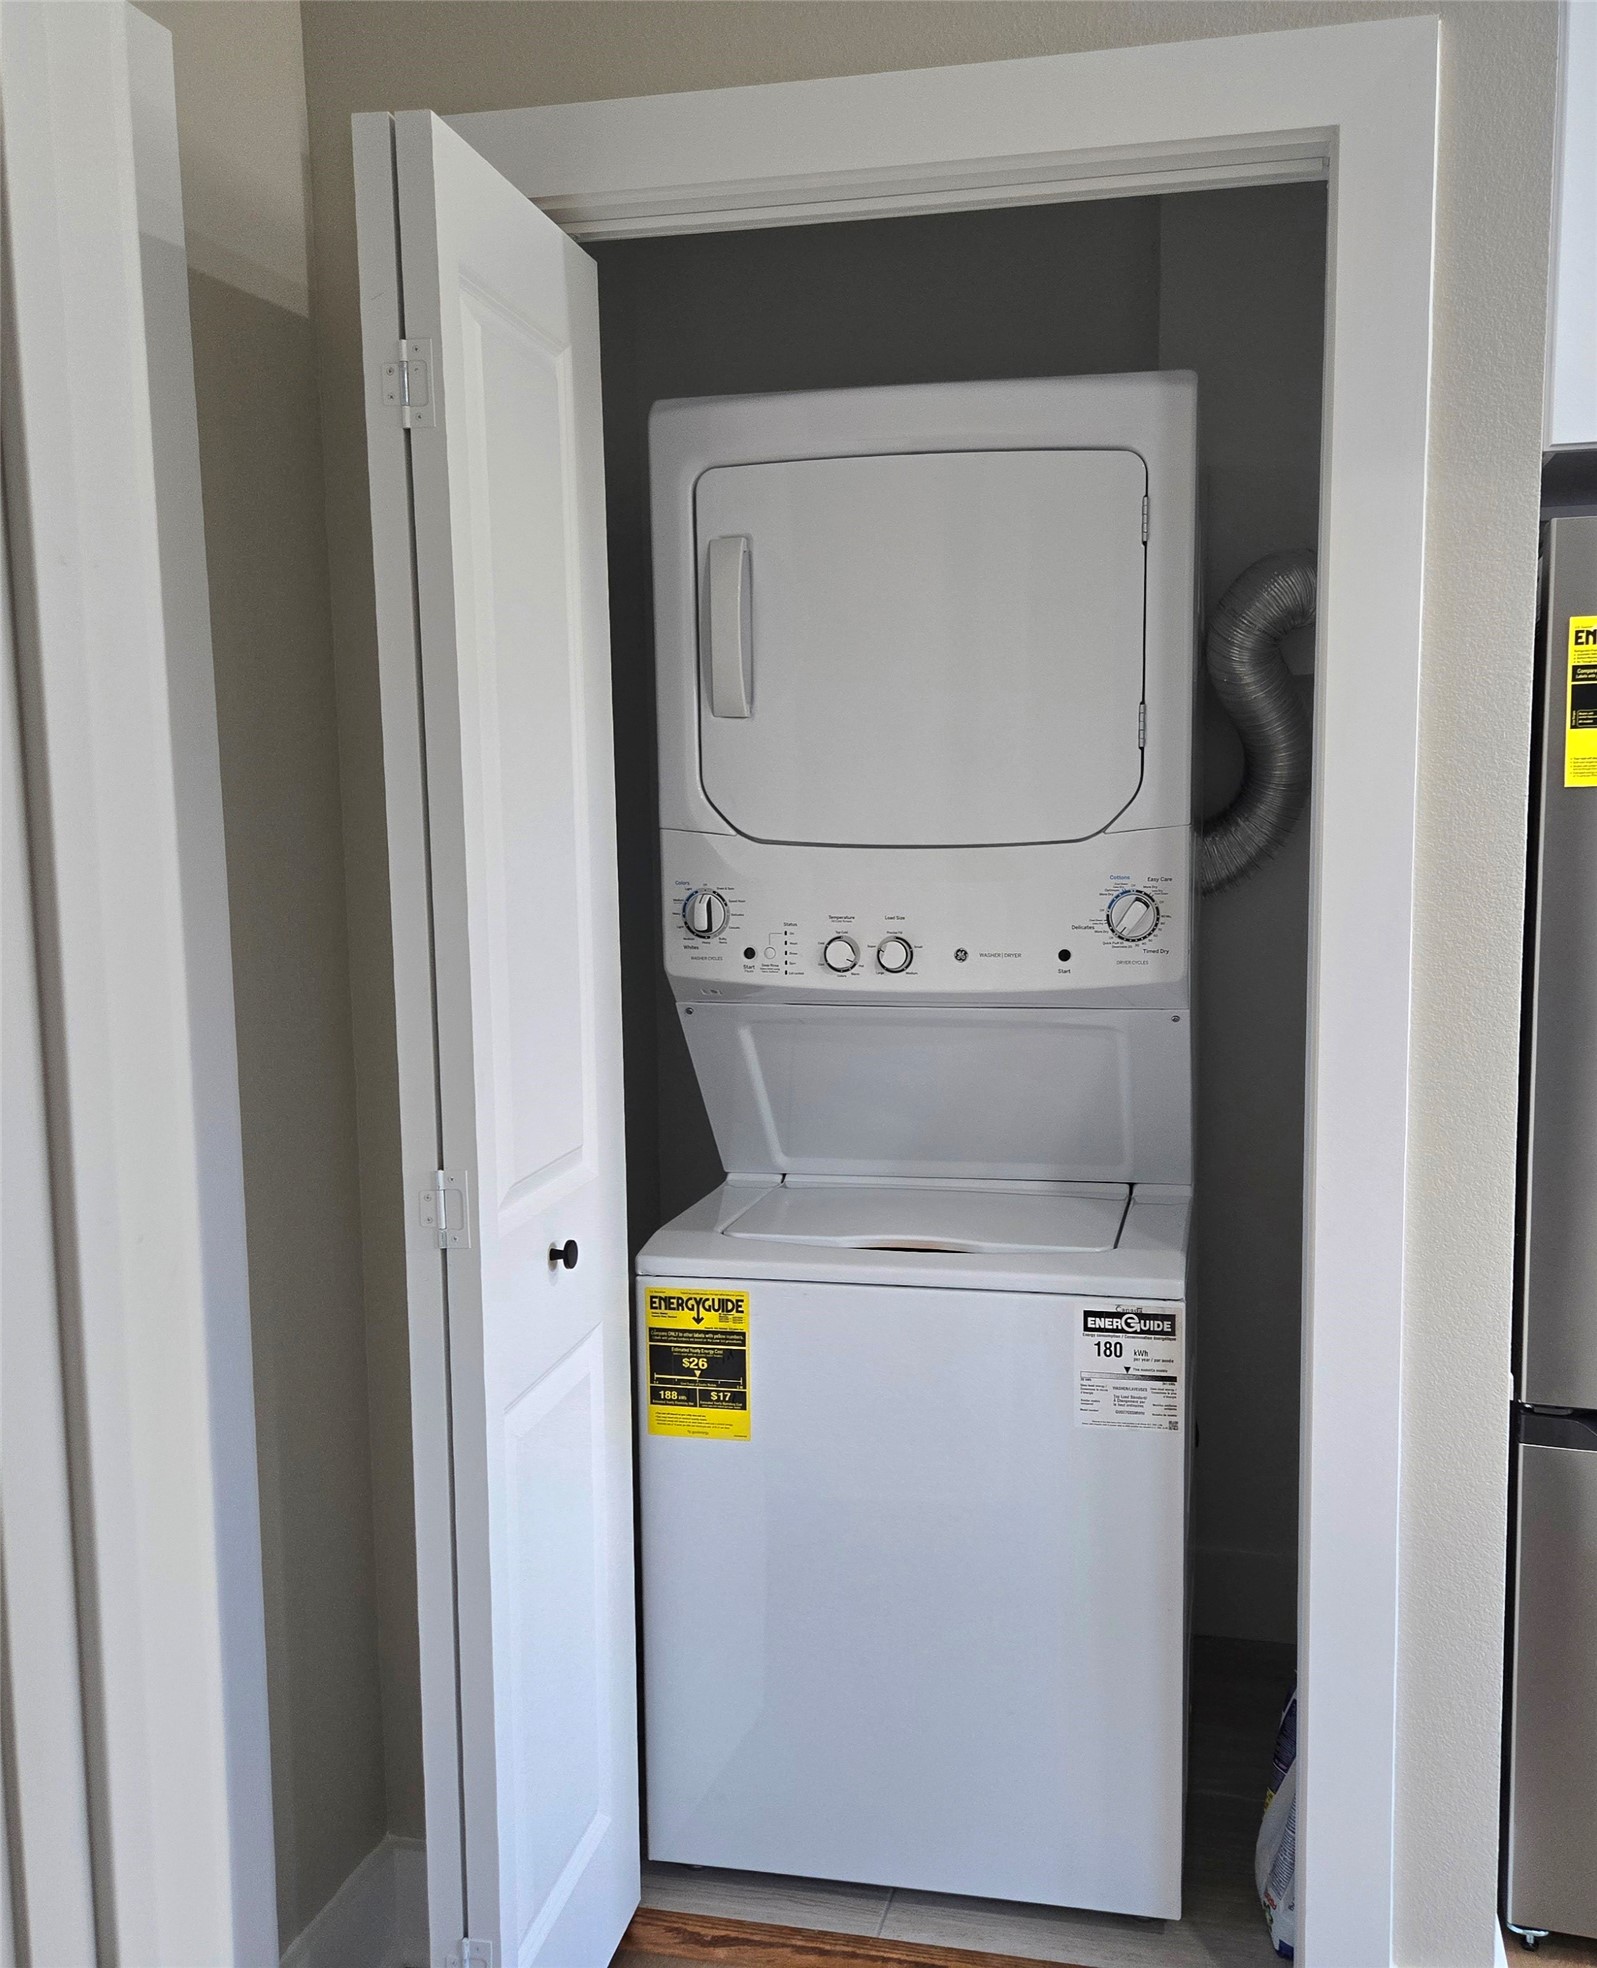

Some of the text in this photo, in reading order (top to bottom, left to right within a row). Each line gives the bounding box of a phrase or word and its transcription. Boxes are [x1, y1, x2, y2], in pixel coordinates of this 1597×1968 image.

[650, 1295, 744, 1314] ENERGYGUIDE
[1094, 1340, 1122, 1358] 180
[682, 1358, 708, 1370] $26
[659, 1390, 678, 1400] 188
[710, 1392, 731, 1401] $17
